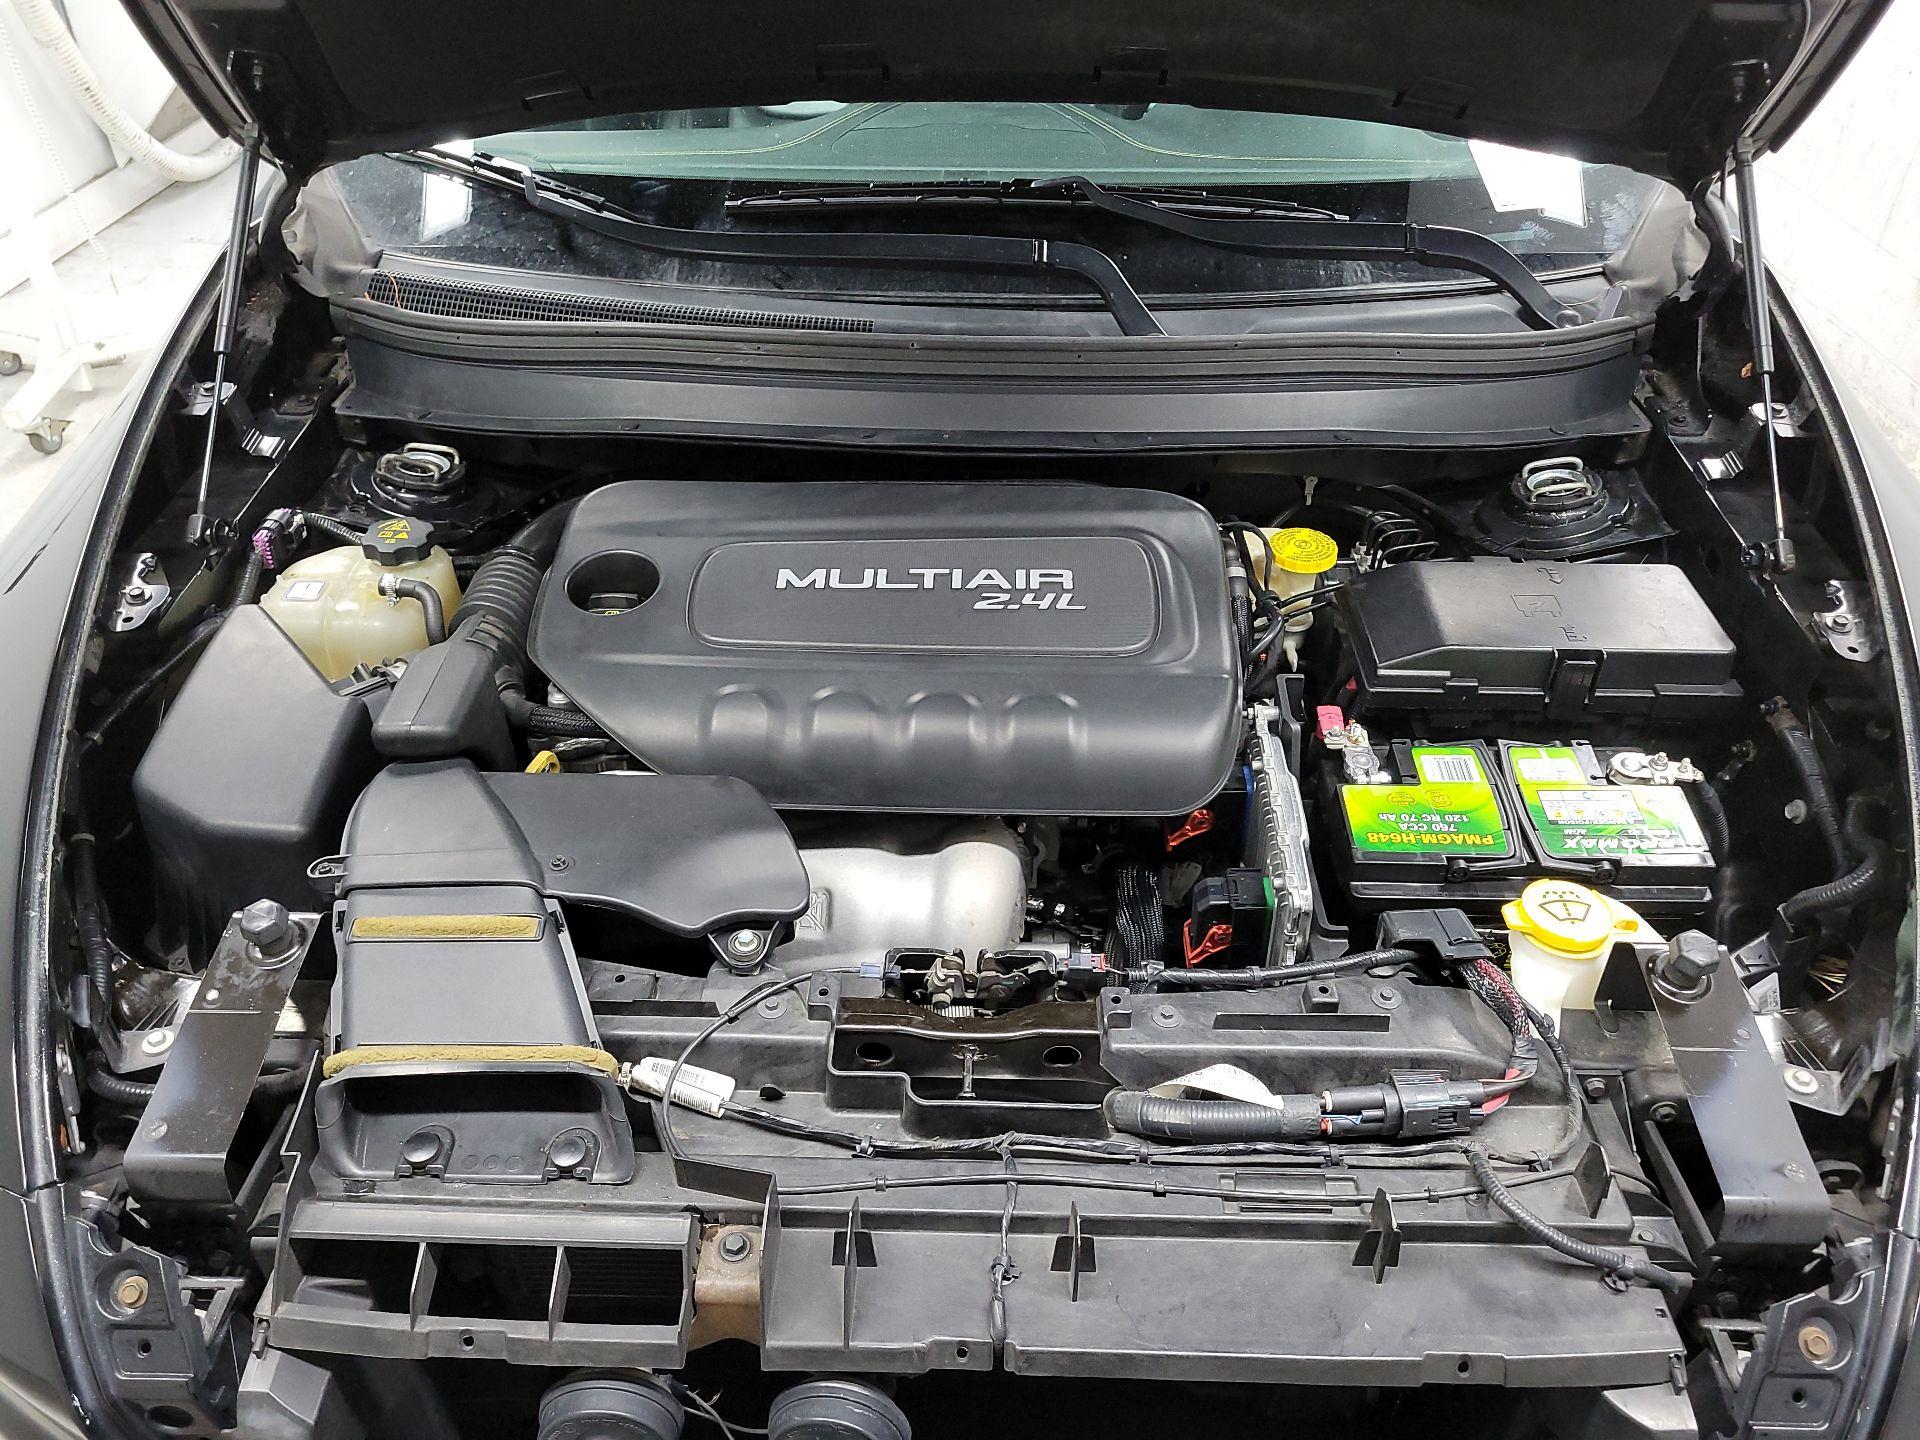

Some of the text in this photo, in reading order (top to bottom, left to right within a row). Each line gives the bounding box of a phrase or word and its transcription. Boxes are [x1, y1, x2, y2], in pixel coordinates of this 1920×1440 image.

[775, 568, 1074, 590] MULTIAIR
[972, 592, 1086, 610] 2.4L
[1378, 812, 1470, 822] 120 RC 70 Ah
[1398, 822, 1458, 832] 760 CCA
[1564, 828, 1587, 836] AGM
[1366, 832, 1495, 845] PMAGM-H648
